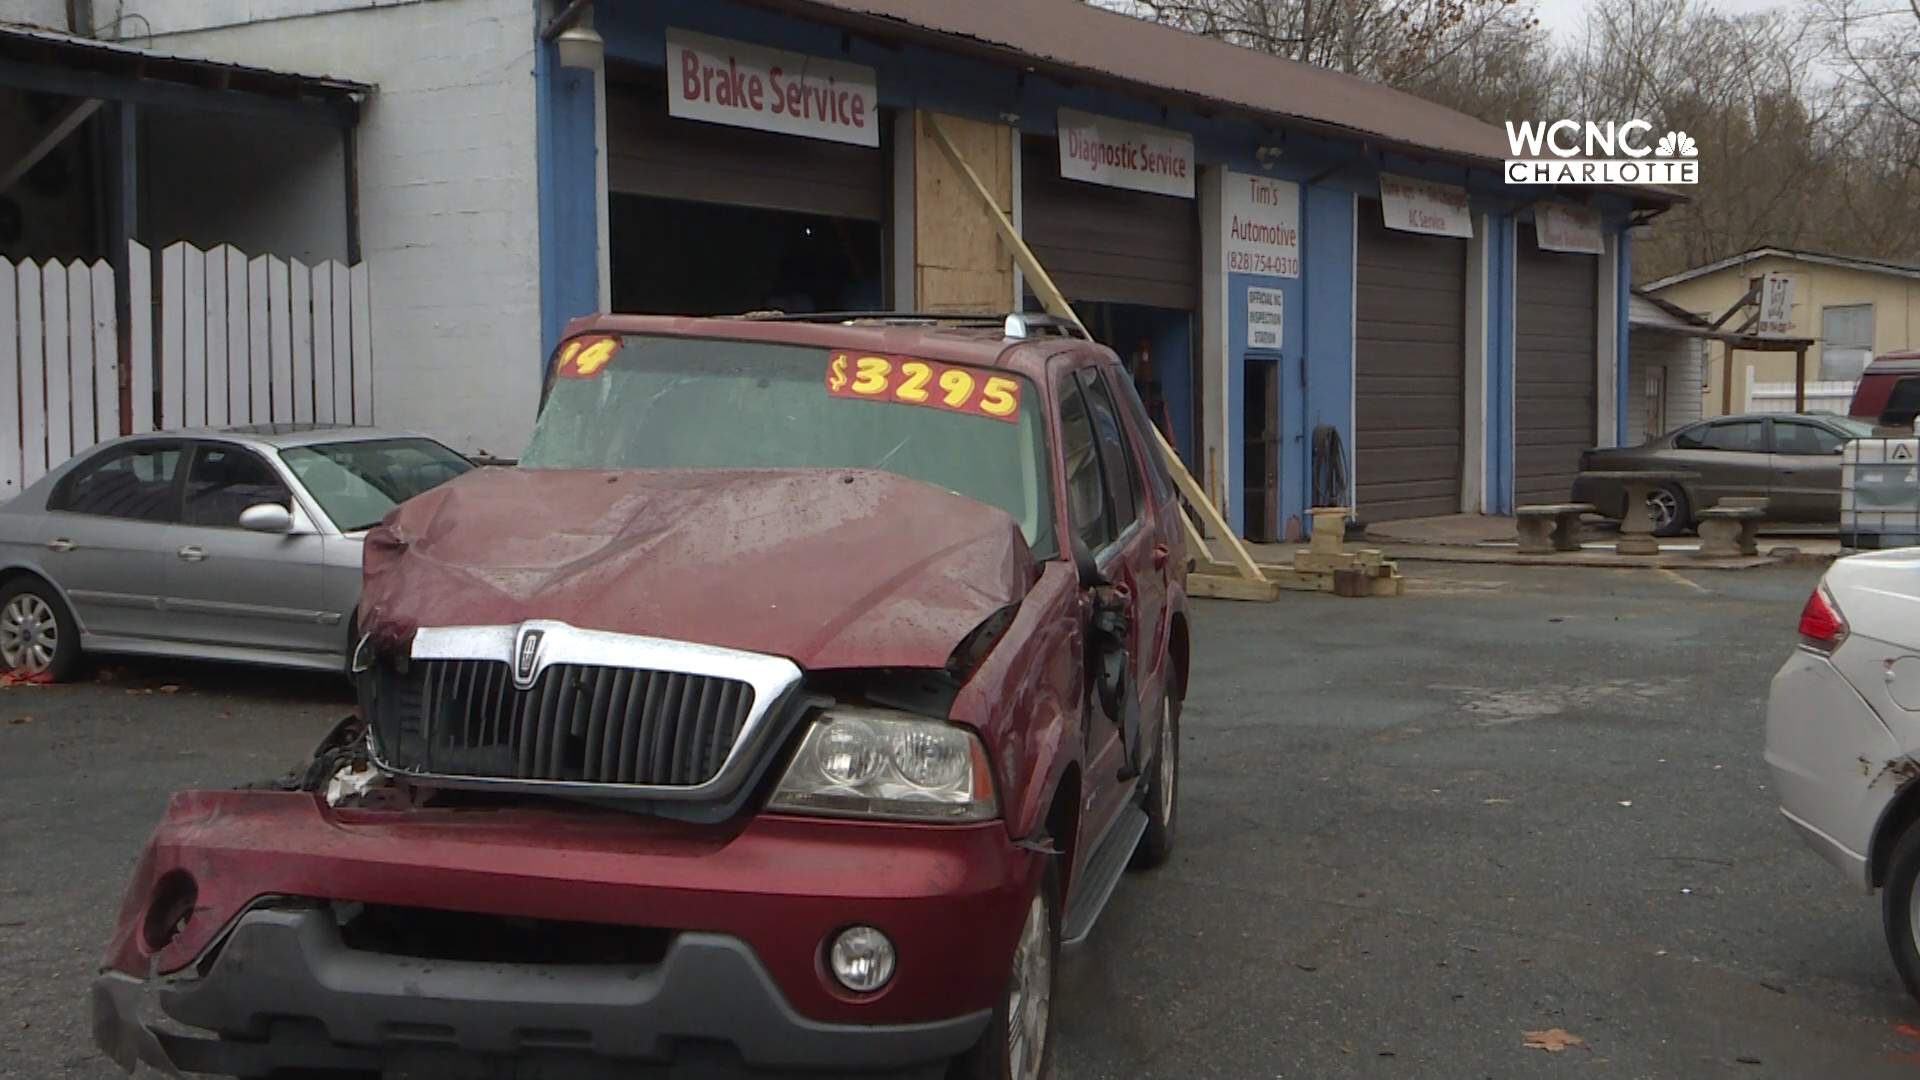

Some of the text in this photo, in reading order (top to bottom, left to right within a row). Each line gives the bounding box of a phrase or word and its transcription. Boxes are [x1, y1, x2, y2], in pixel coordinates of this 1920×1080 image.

[681, 49, 865, 128] Brake Service
[1068, 126, 1186, 178] Diagnostic Service
[1249, 177, 1278, 206] Tim's
[1230, 213, 1297, 247] Automotive
[1249, 290, 1273, 306] OFFICIAL
[1249, 311, 1282, 326] INSPECTION
[1254, 331, 1276, 344] STATION
[829, 354, 1019, 416] $3295
